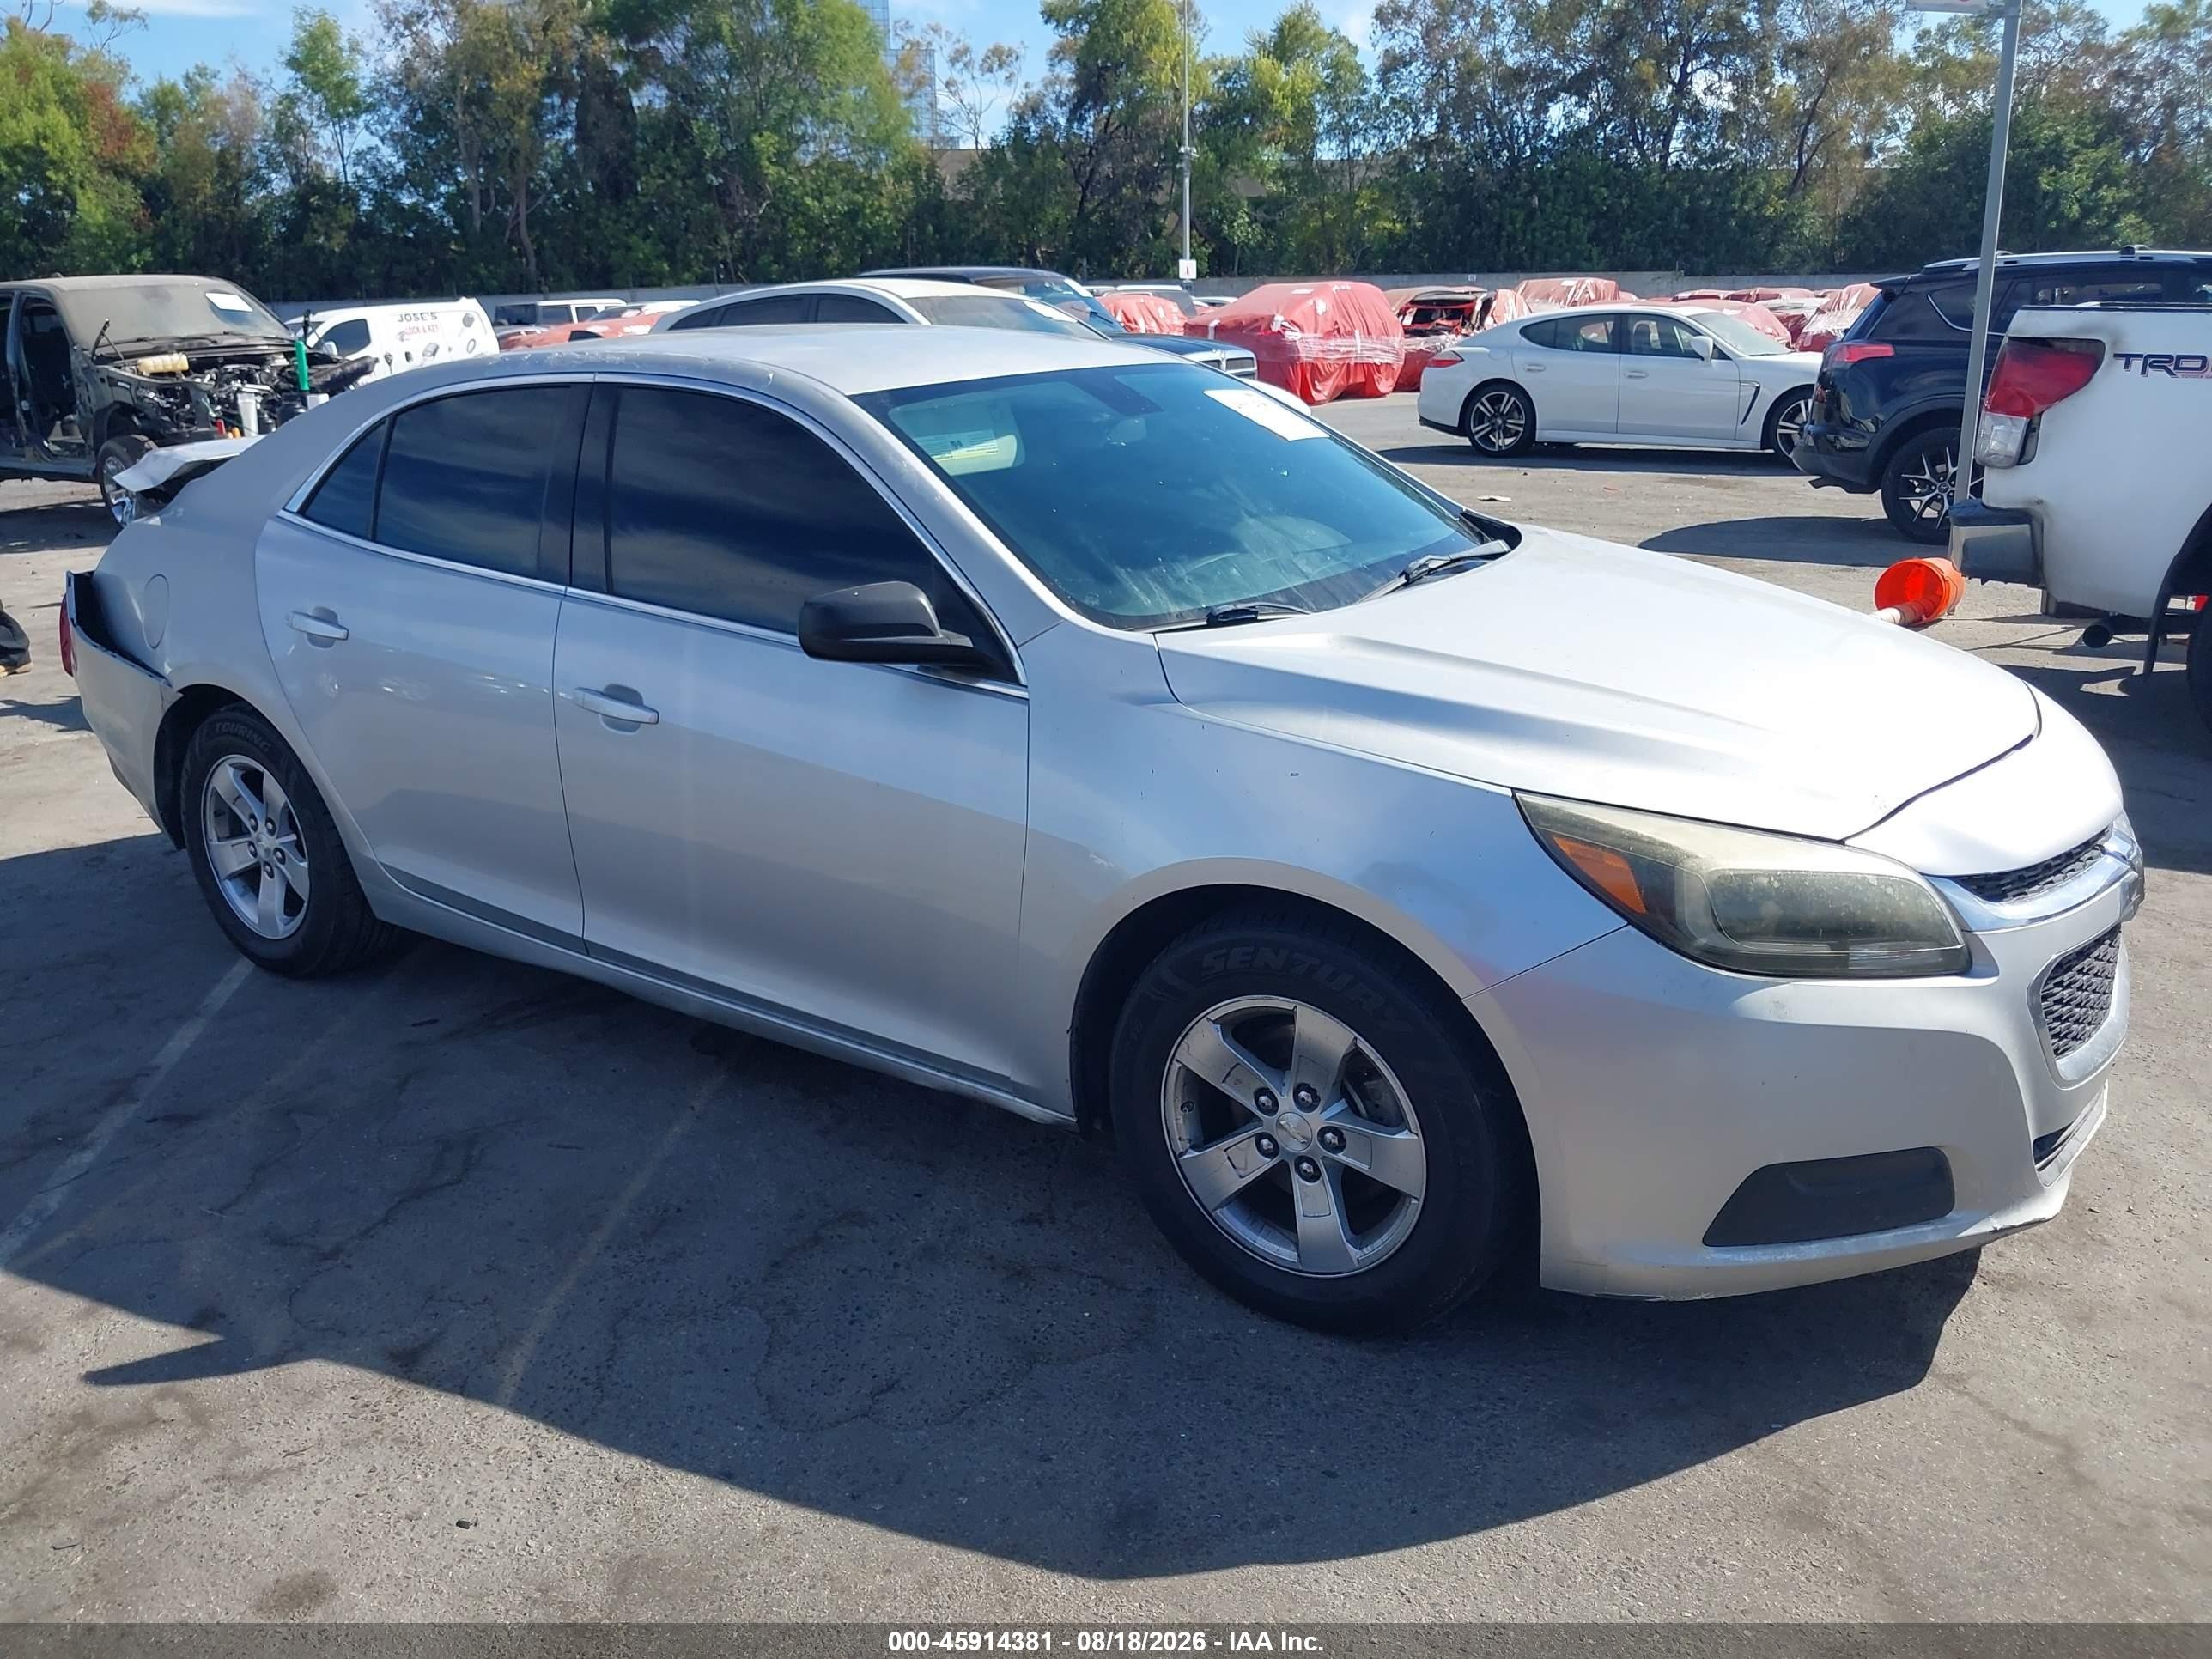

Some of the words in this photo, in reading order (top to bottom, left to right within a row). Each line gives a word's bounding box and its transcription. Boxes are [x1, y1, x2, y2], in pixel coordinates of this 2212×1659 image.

[398, 311, 438, 323] JOSE'S
[2113, 353, 2209, 378] TRD
[214, 720, 270, 753] TOURING
[1201, 946, 1413, 1032] SENTURY
